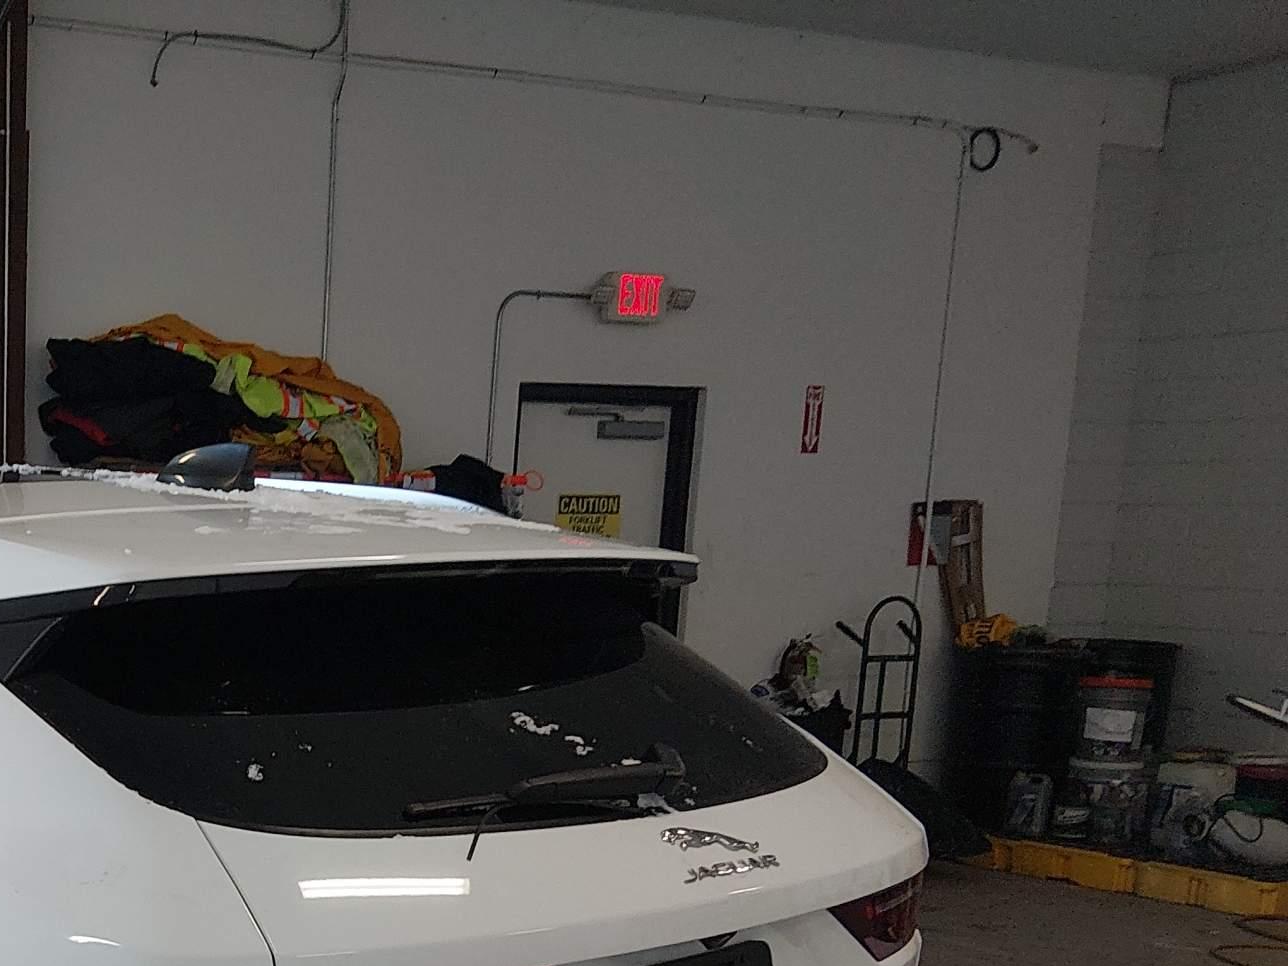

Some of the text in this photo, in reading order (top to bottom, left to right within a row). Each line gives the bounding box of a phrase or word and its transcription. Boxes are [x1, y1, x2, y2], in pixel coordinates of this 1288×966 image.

[618, 273, 665, 316] EXIT
[559, 496, 619, 514] CAUTION
[683, 854, 781, 885] JAGUAR
